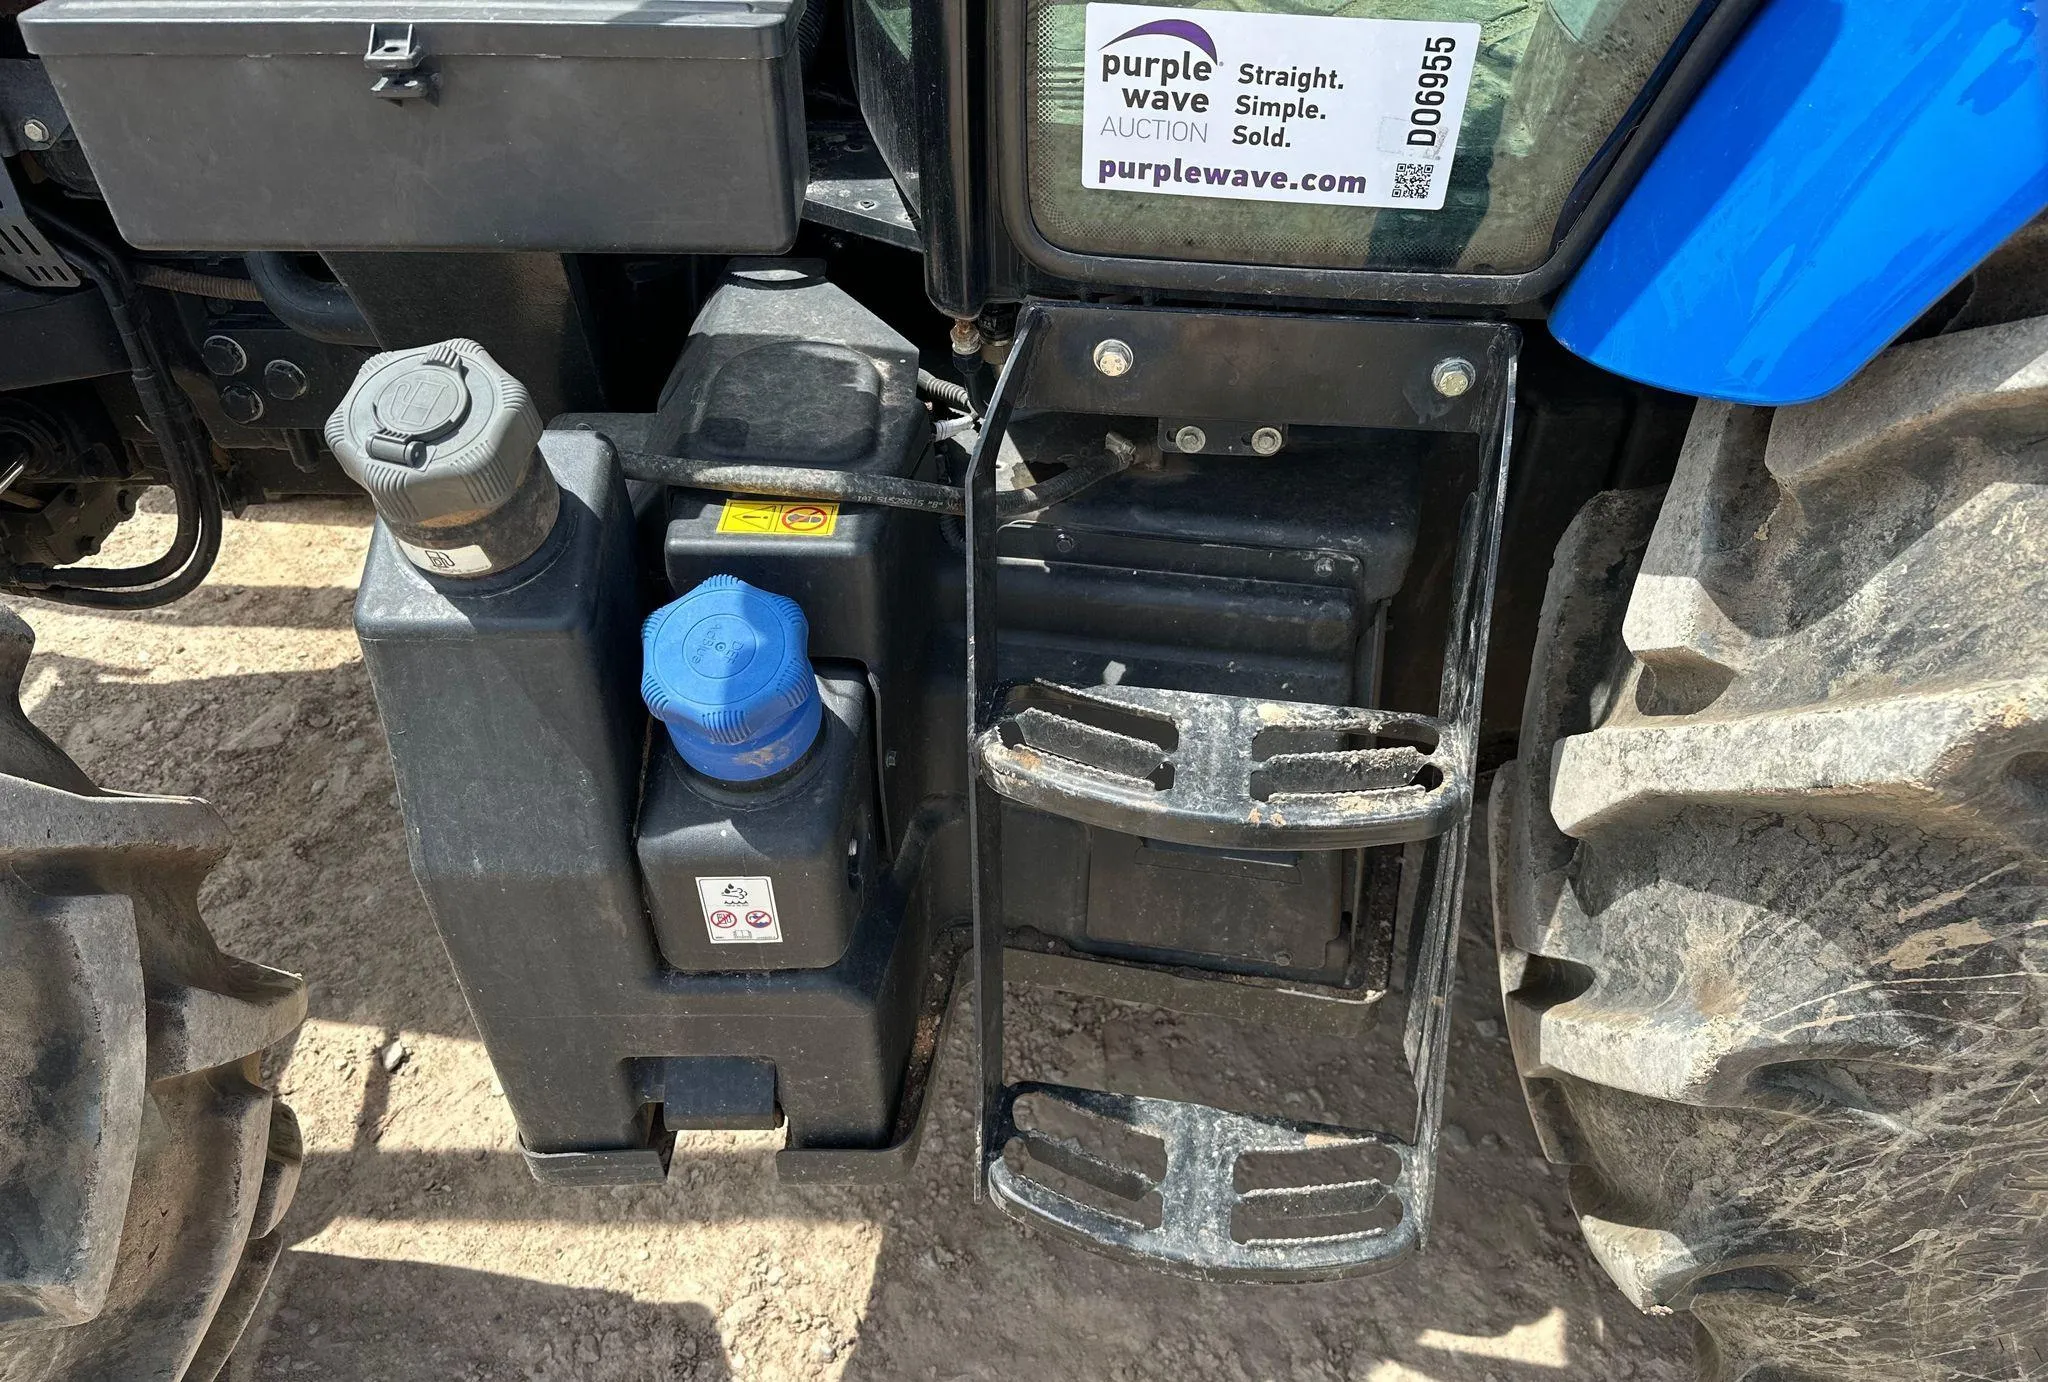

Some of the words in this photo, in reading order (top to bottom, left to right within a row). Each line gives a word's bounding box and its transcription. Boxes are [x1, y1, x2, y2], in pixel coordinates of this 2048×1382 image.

[1102, 51, 1212, 86] purple
[1237, 63, 1344, 93] Straight.
[1122, 87, 1209, 113] wave
[1407, 37, 1456, 146] D06955
[1234, 94, 1326, 122] Simple.
[1100, 116, 1208, 143] AUCTION
[1232, 125, 1291, 148] Sold.
[1099, 157, 1367, 194] purplewave.com
